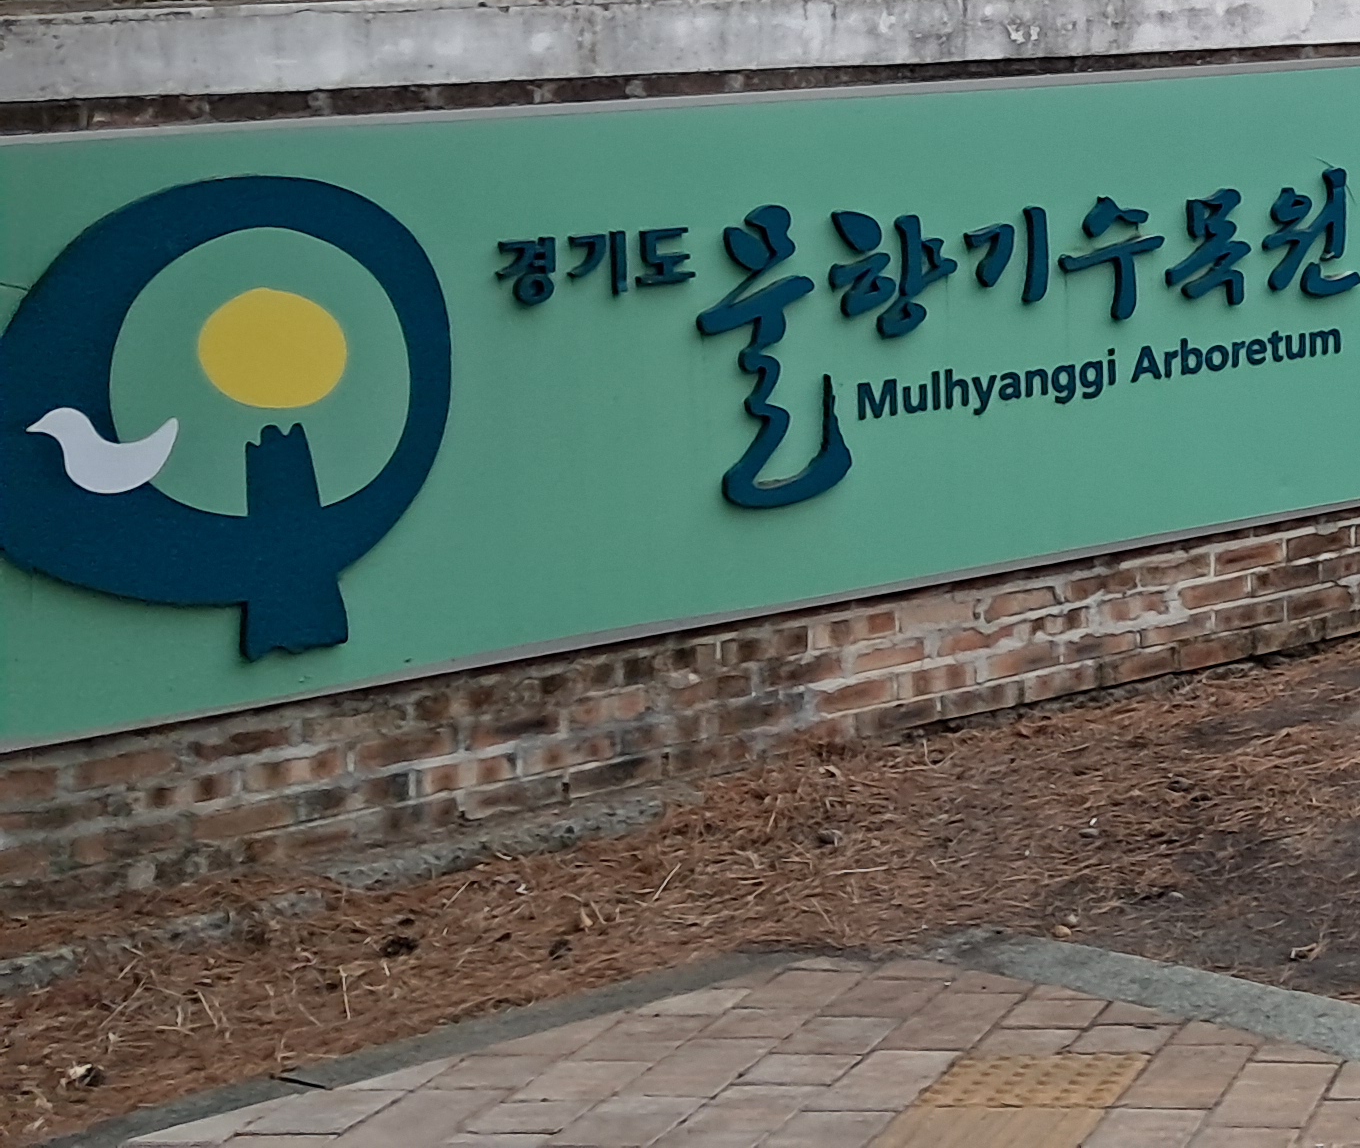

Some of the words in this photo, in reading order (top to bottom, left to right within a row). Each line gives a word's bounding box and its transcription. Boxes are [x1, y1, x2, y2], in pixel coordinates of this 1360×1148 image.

[494, 226, 697, 307] 경기도
[856, 347, 1118, 422] Mulhyanggi
[1130, 324, 1343, 383] Arboretum
